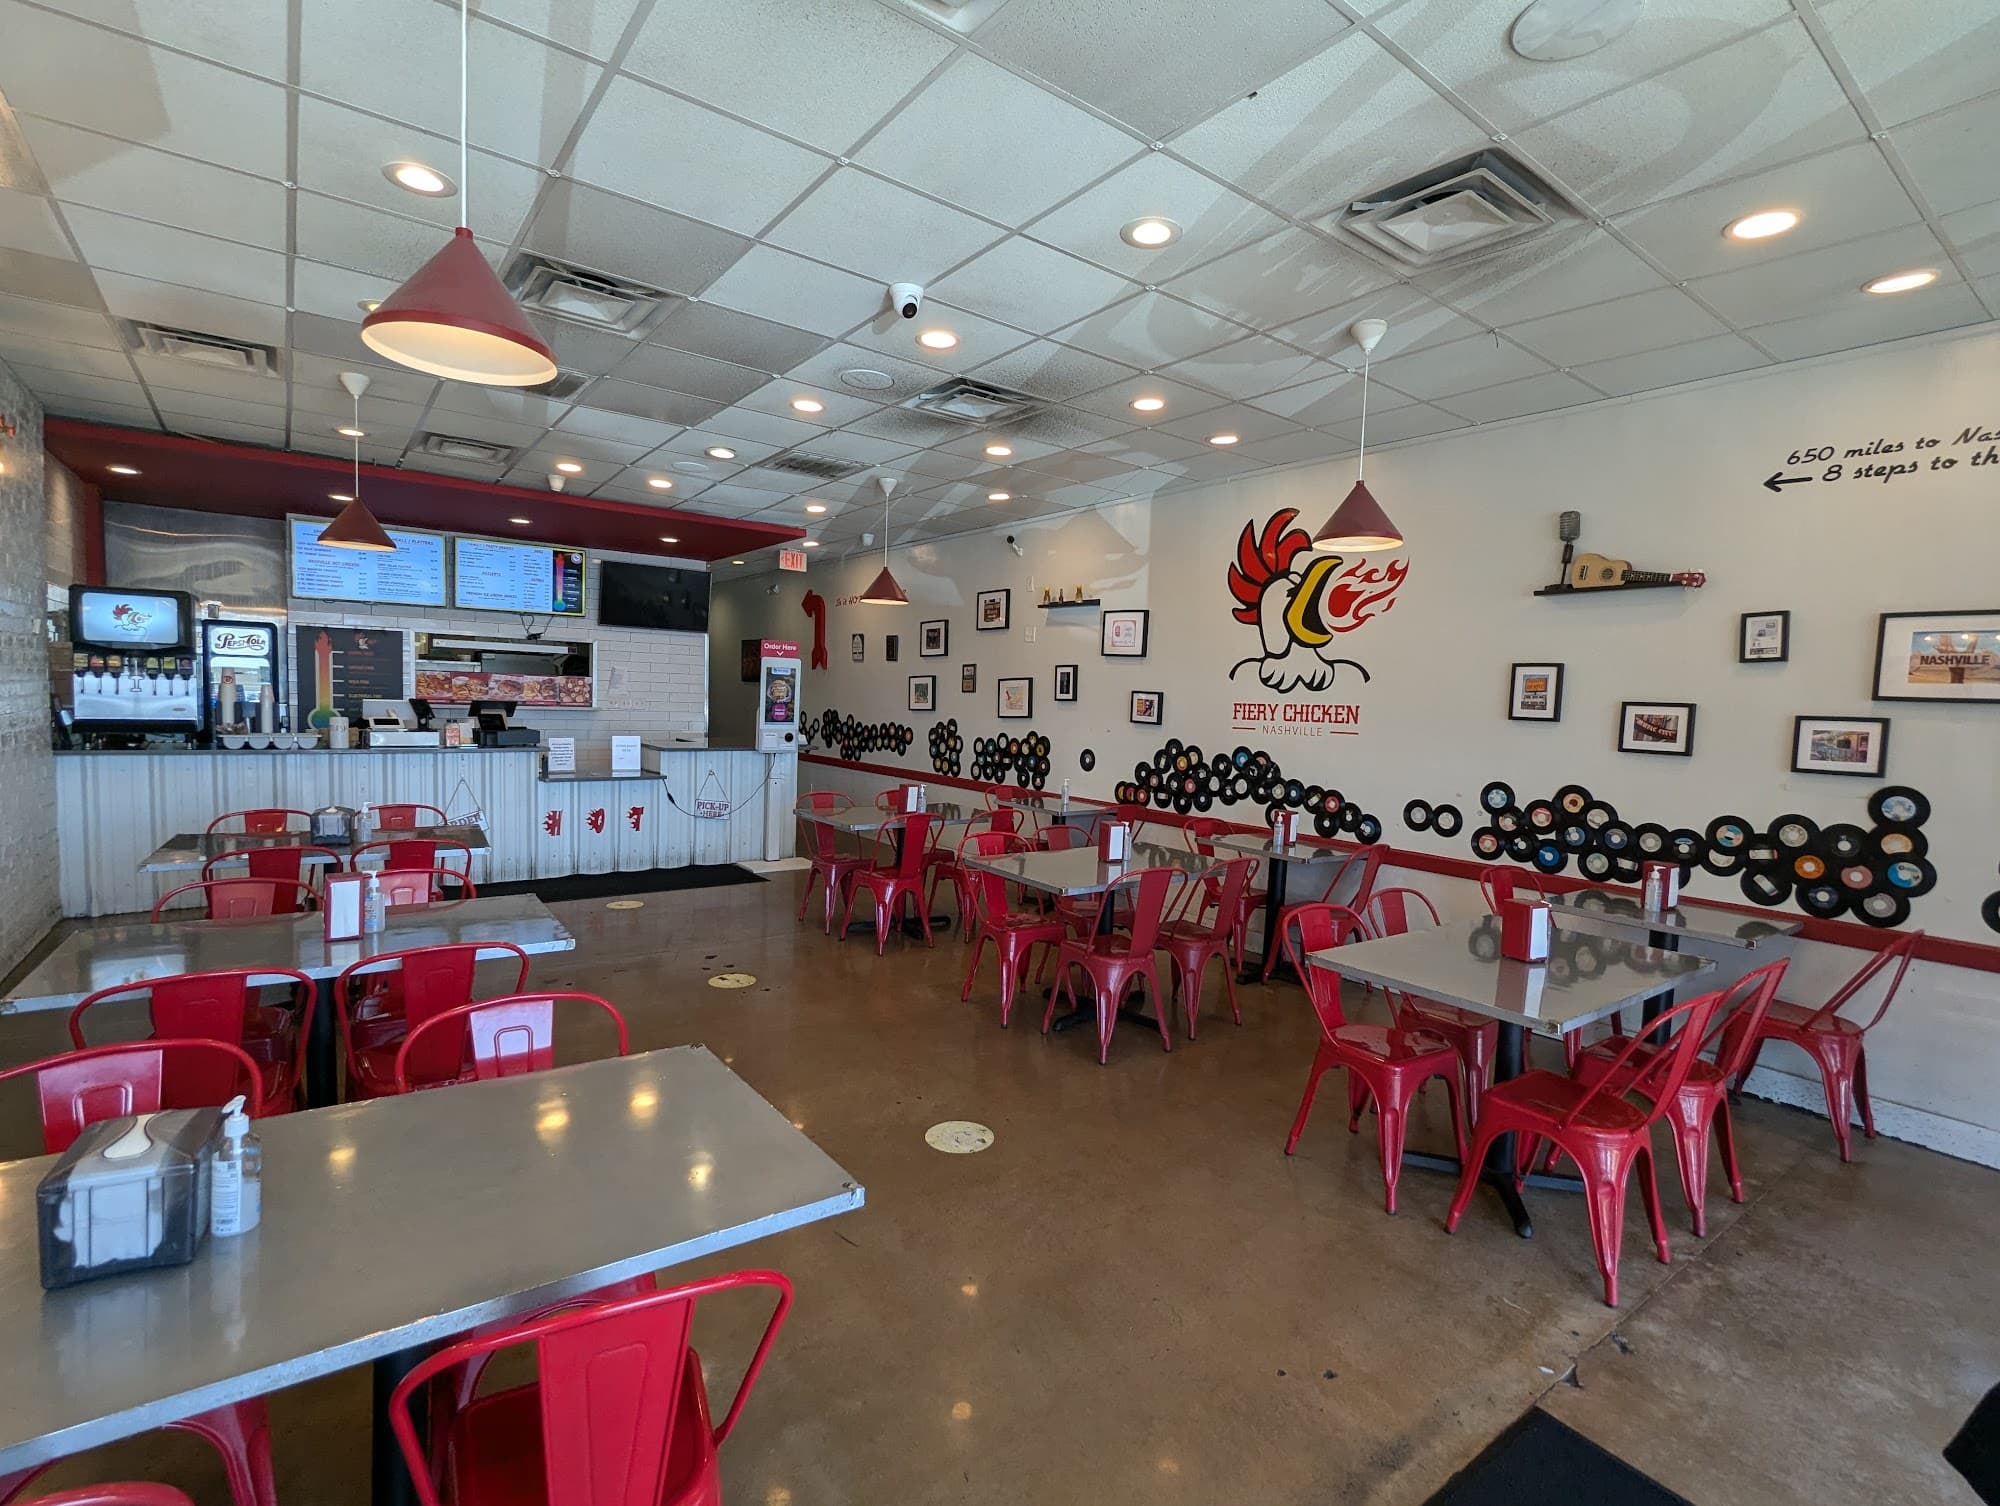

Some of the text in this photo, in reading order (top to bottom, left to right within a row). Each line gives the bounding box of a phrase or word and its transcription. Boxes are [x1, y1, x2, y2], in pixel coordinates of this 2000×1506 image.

[1787, 446, 1835, 465] 650
[1843, 438, 1905, 459] miles
[1915, 437, 1941, 450] to
[1822, 446, 1999, 484] 8 steps to th
[784, 552, 804, 569] EXIT
[764, 642, 781, 650] Order
[1920, 654, 1991, 666] NASHVILLE
[1232, 703, 1361, 725] FIERY CHICKEN
[1262, 725, 1323, 737] NASHVILLE
[696, 801, 730, 811] PICK-UP
